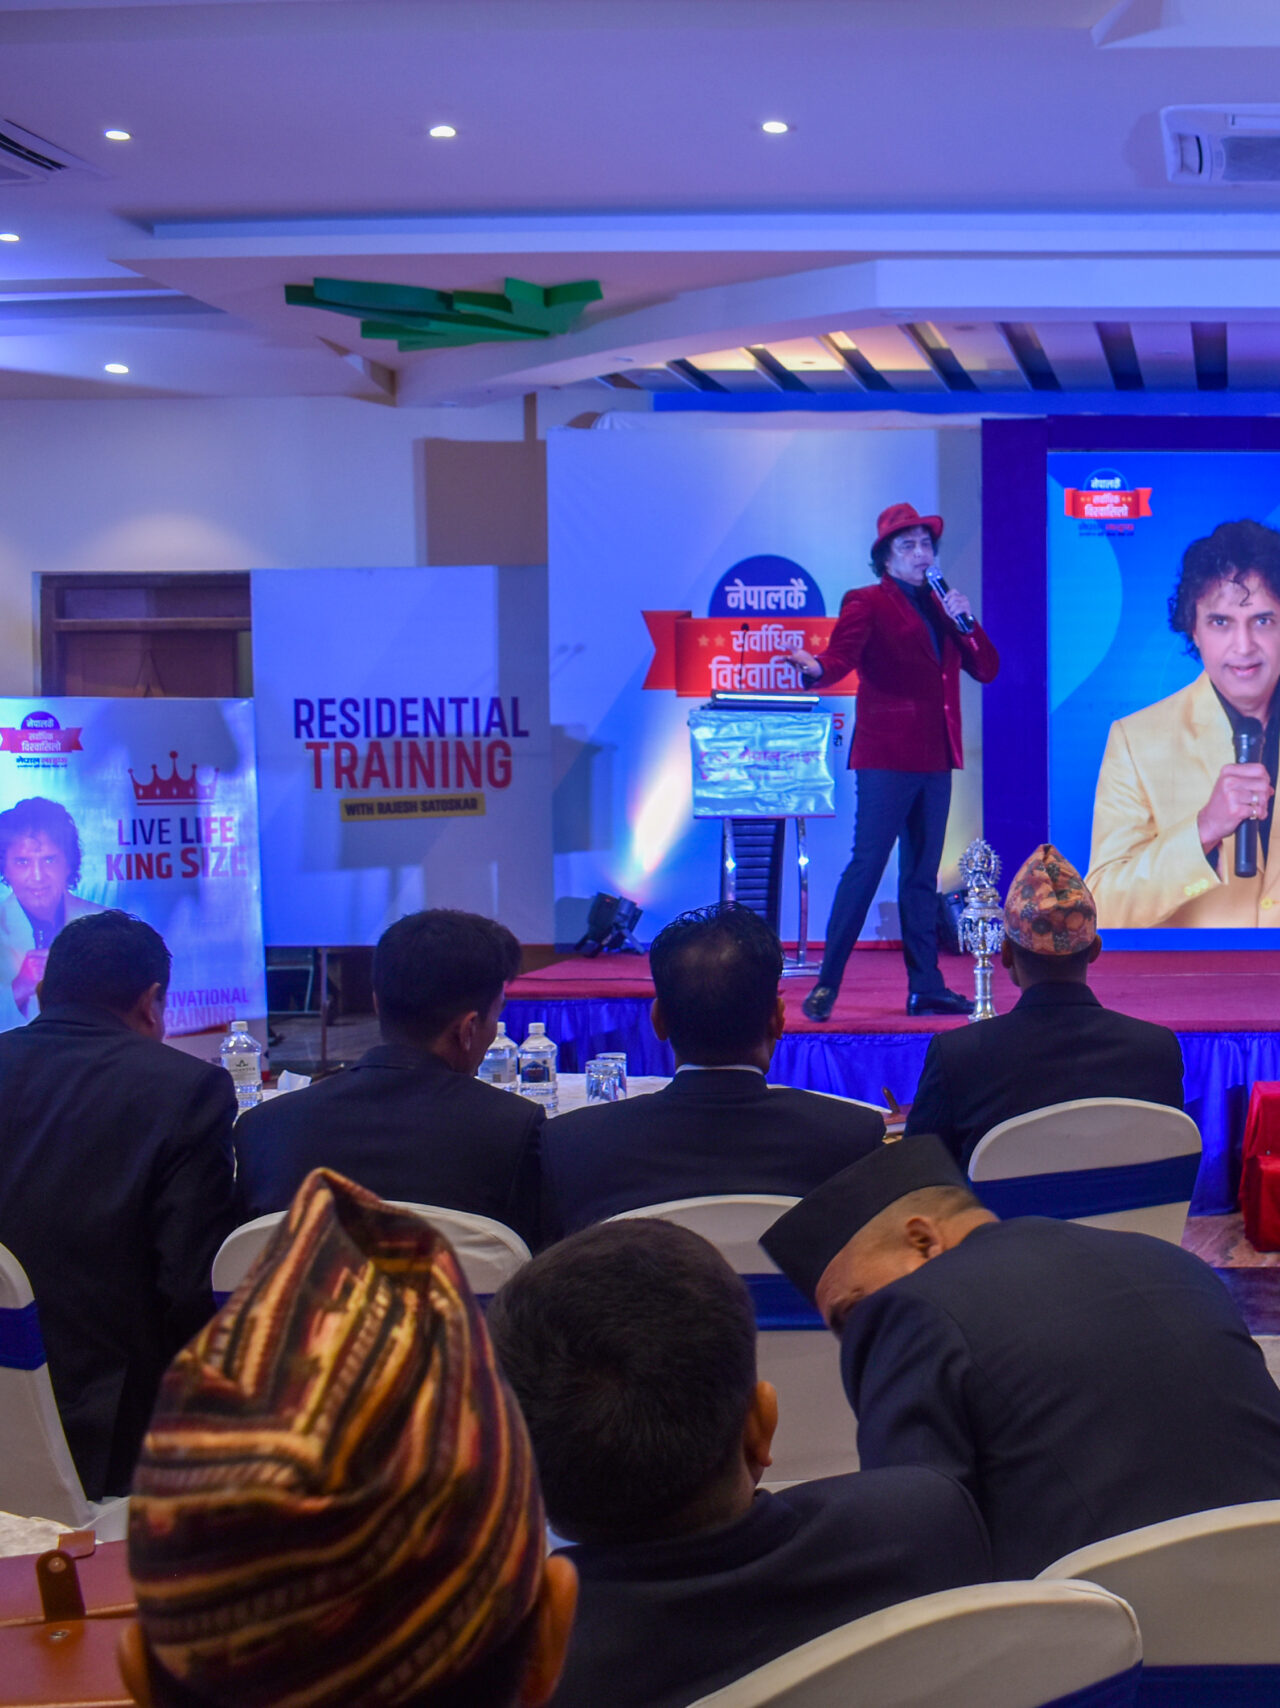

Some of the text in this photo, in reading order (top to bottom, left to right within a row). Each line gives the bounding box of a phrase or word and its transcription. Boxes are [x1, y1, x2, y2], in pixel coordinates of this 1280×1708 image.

[724, 578, 808, 611] नेपालकै
[293, 696, 530, 739] RESIDENTIAL
[305, 739, 513, 790] TRAINING
[344, 803, 375, 816] WITH
[377, 800, 418, 815] RAJESH
[118, 816, 235, 846] LIVE LIFE
[105, 845, 247, 881] KING SIZE
[164, 1005, 236, 1028] RAINING
